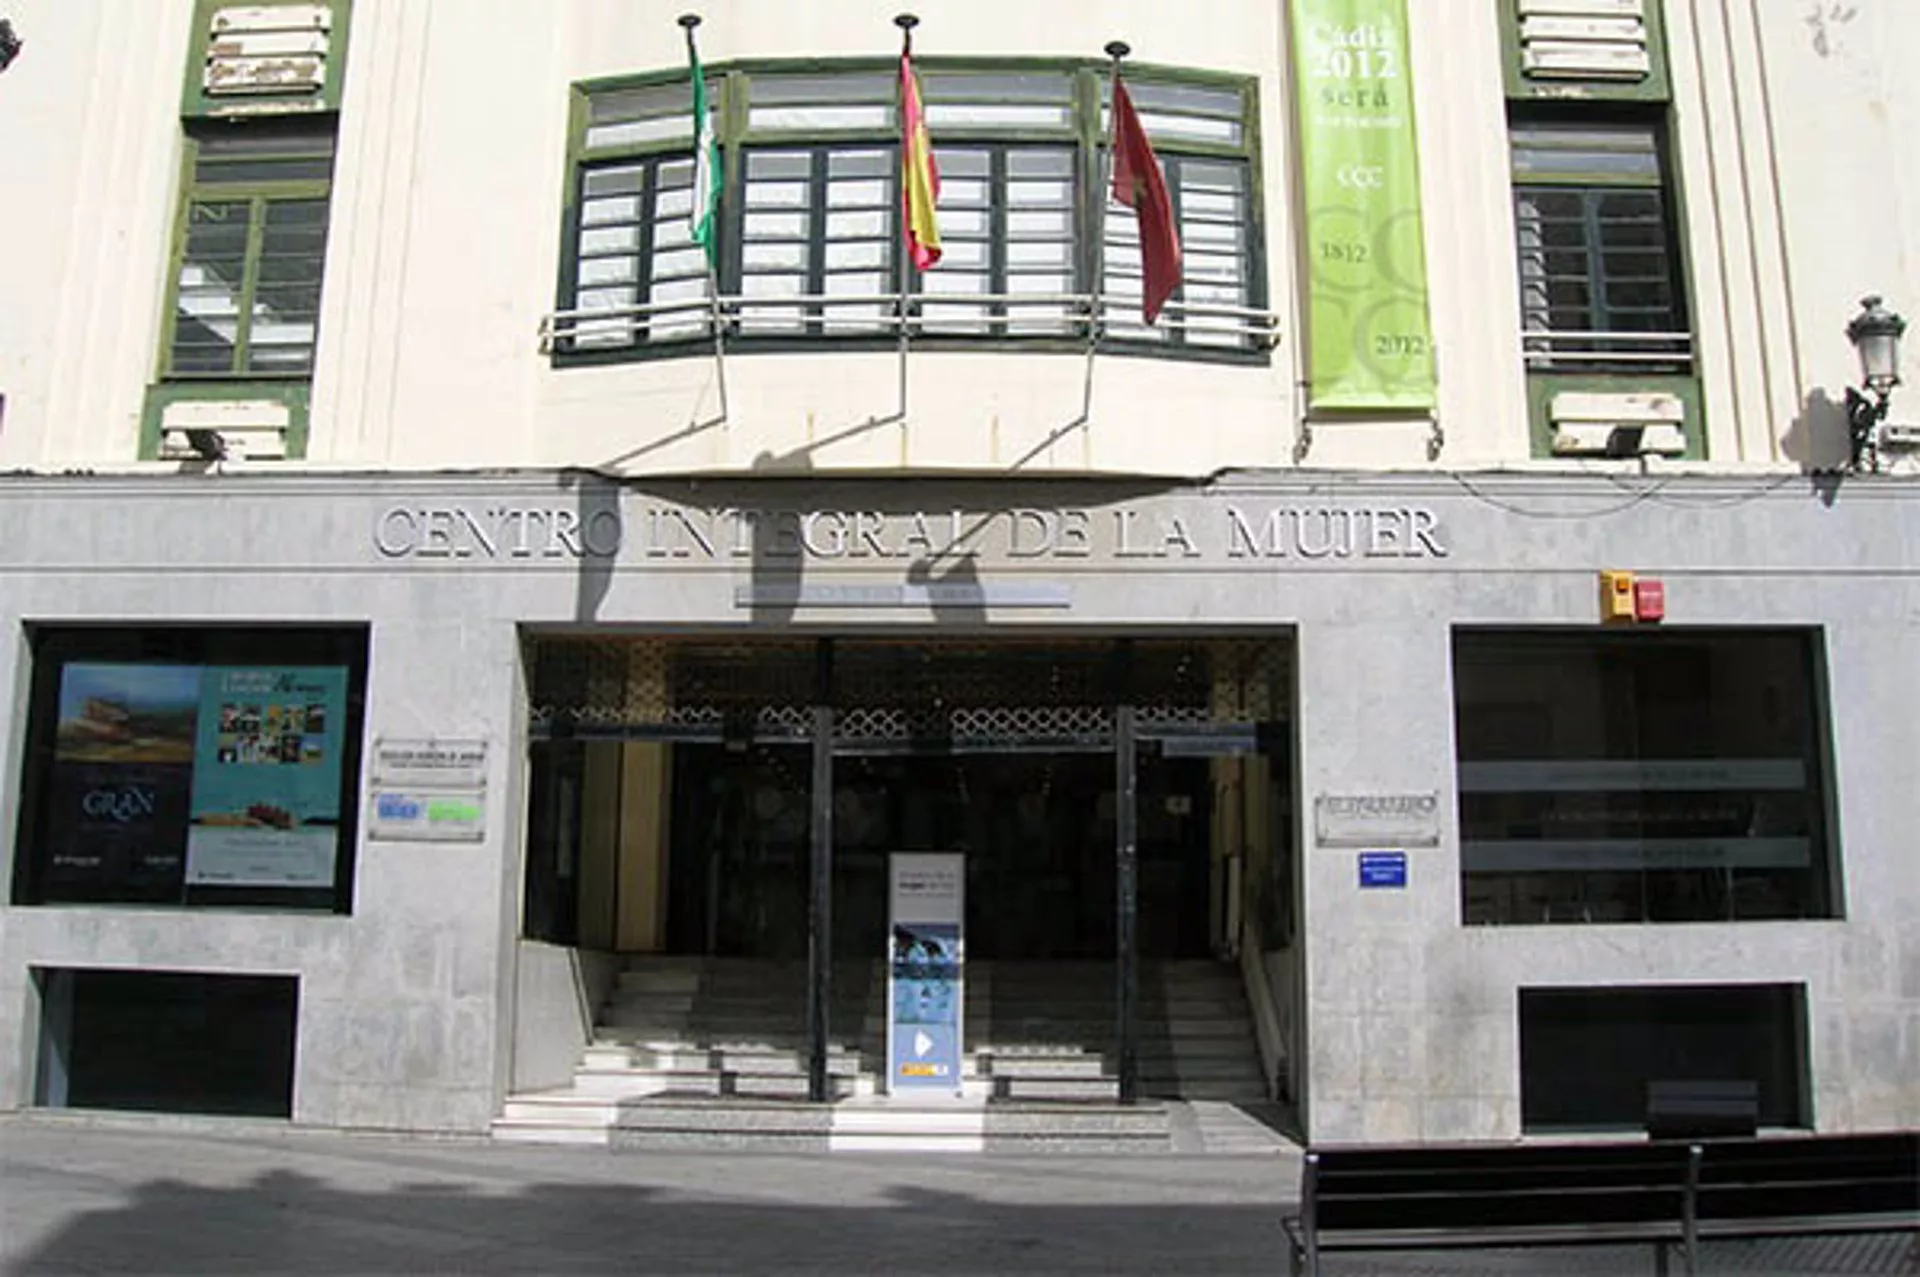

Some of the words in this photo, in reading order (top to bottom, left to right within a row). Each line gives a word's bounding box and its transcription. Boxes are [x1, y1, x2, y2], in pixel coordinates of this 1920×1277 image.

[1310, 50, 1397, 78] 2012
[1322, 243, 1367, 264] 1812
[1376, 334, 1425, 355] 2012
[374, 508, 621, 558] CENTRO
[647, 509, 981, 558] INTEGRAL
[1006, 509, 1090, 558] DE
[1113, 510, 1201, 558] LA
[1227, 506, 1449, 558] MUJER
